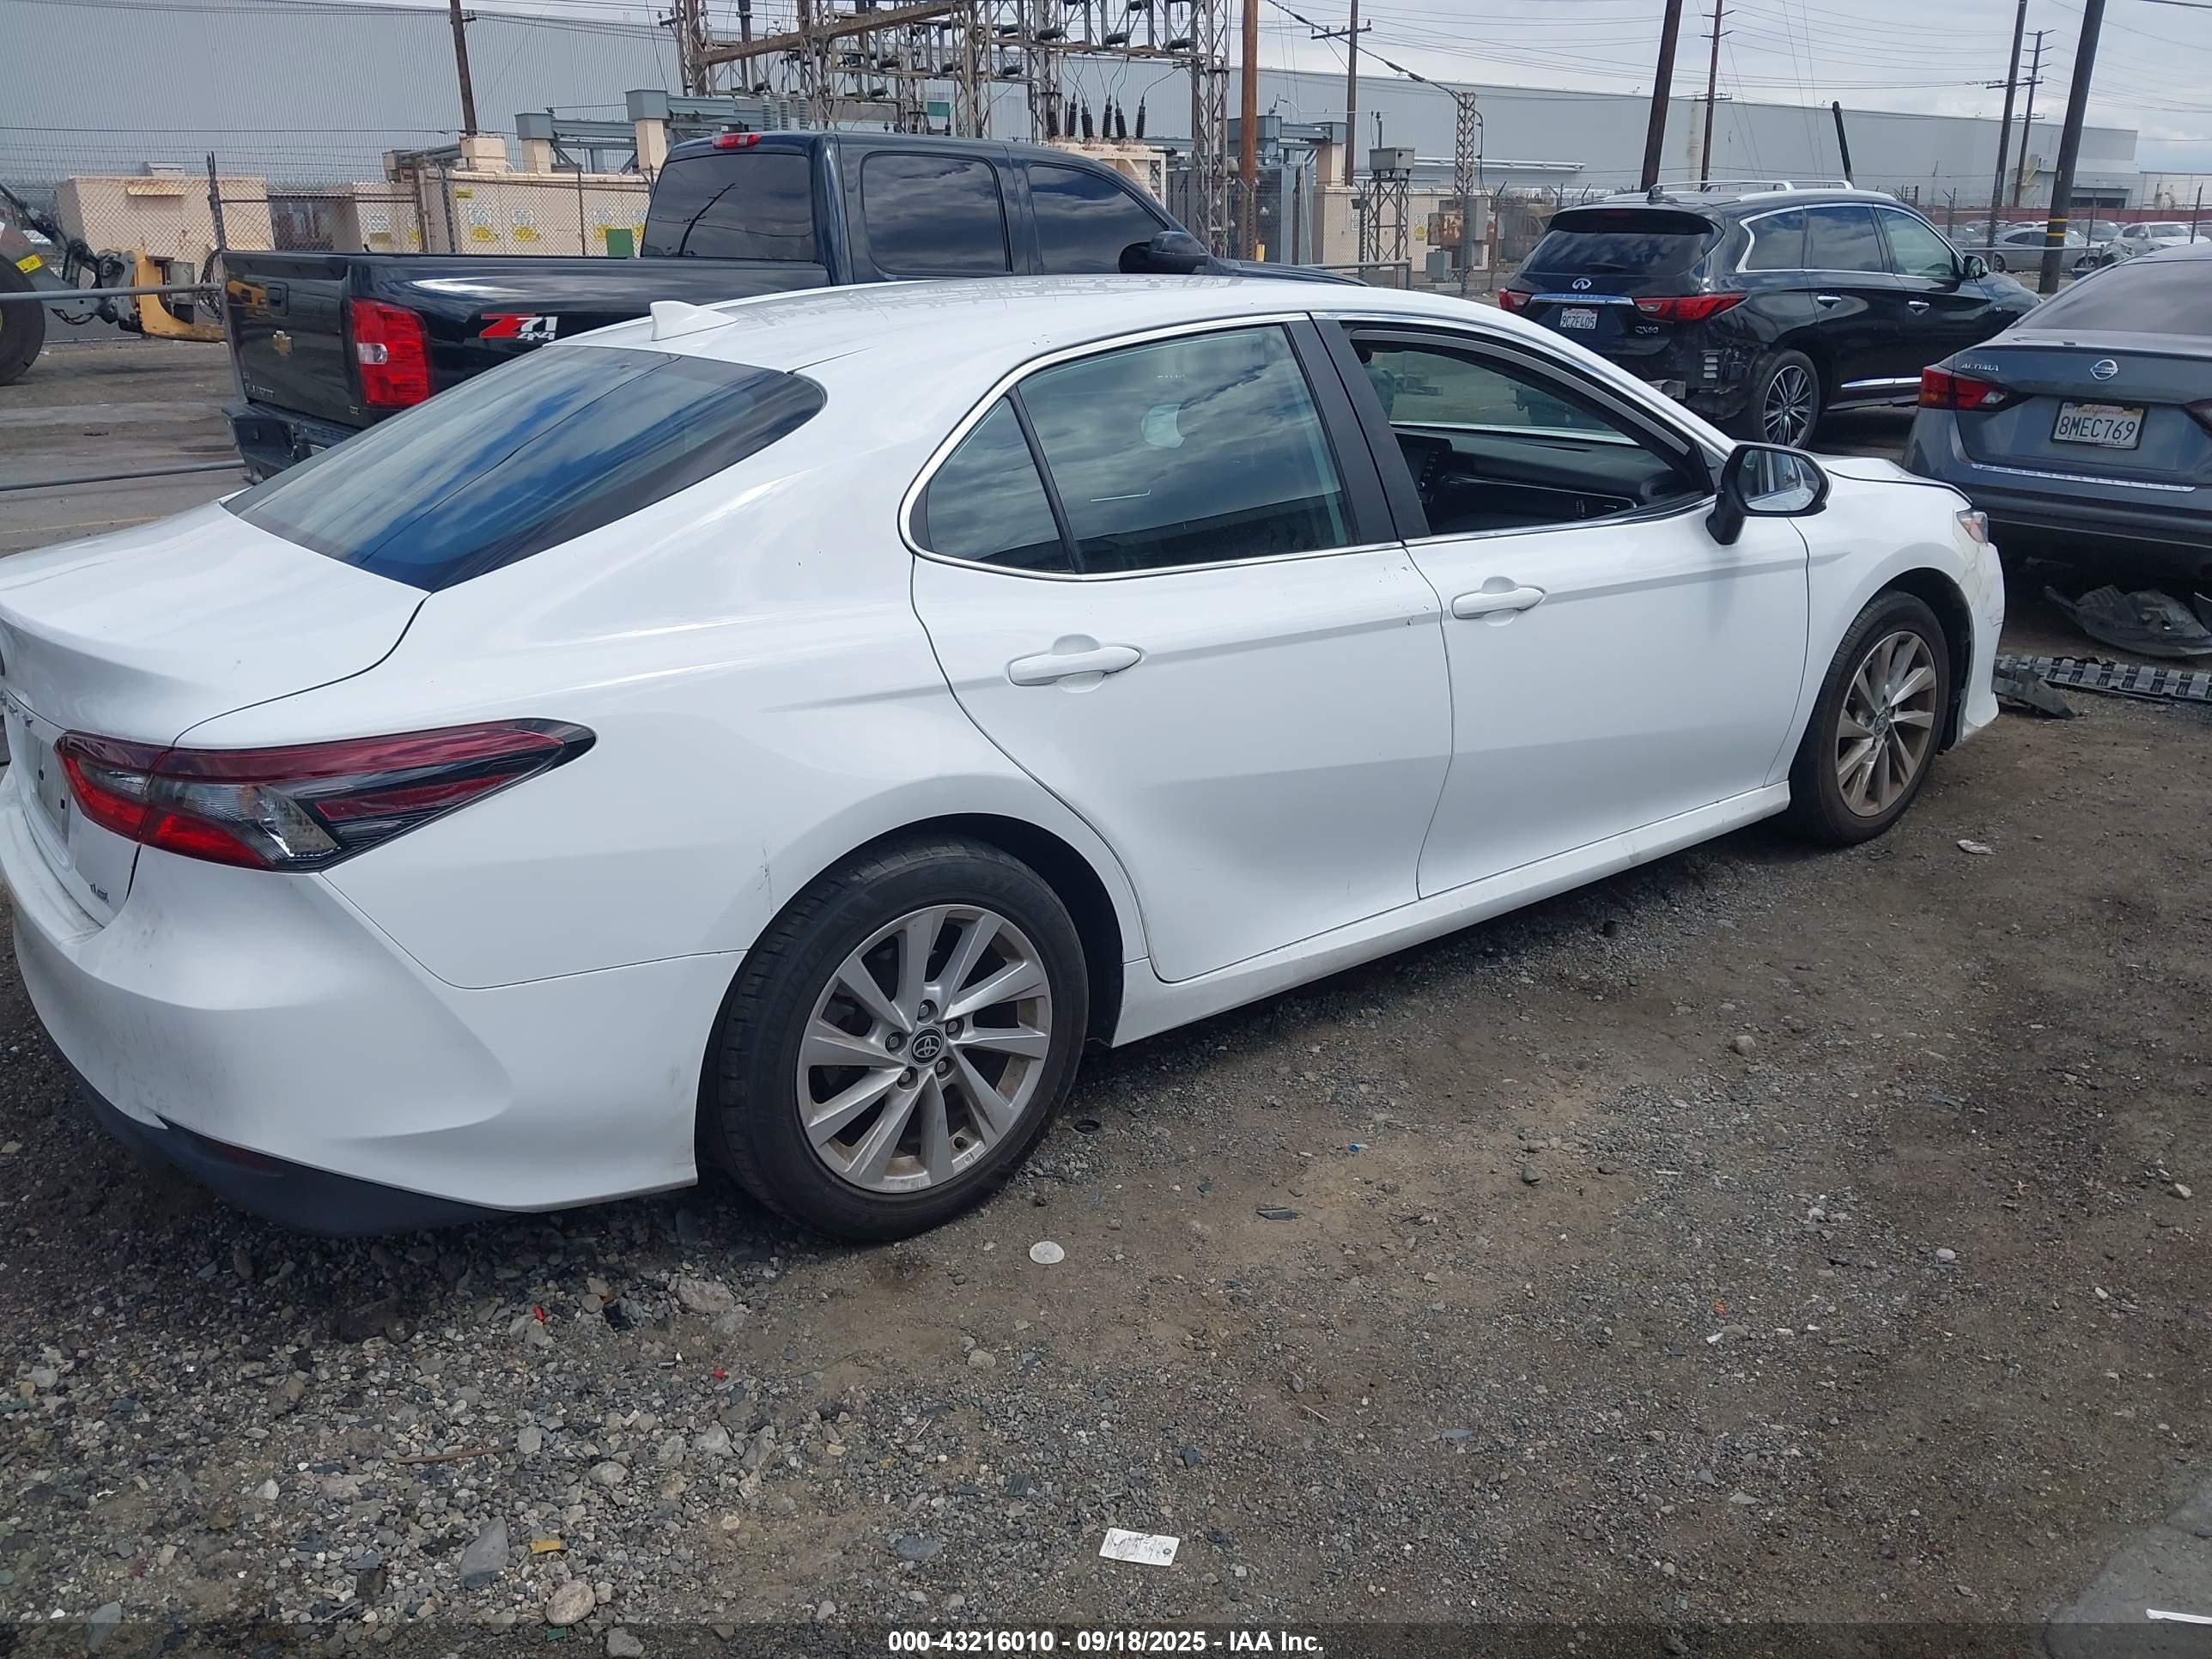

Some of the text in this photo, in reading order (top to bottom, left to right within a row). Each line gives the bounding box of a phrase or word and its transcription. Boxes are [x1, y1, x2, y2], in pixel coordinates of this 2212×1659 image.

[479, 313, 558, 339] Z71
[1561, 315, 1595, 329] 9CZF405
[1960, 362, 2000, 372] ALTIMA
[2058, 416, 2136, 441] 8MEC769
